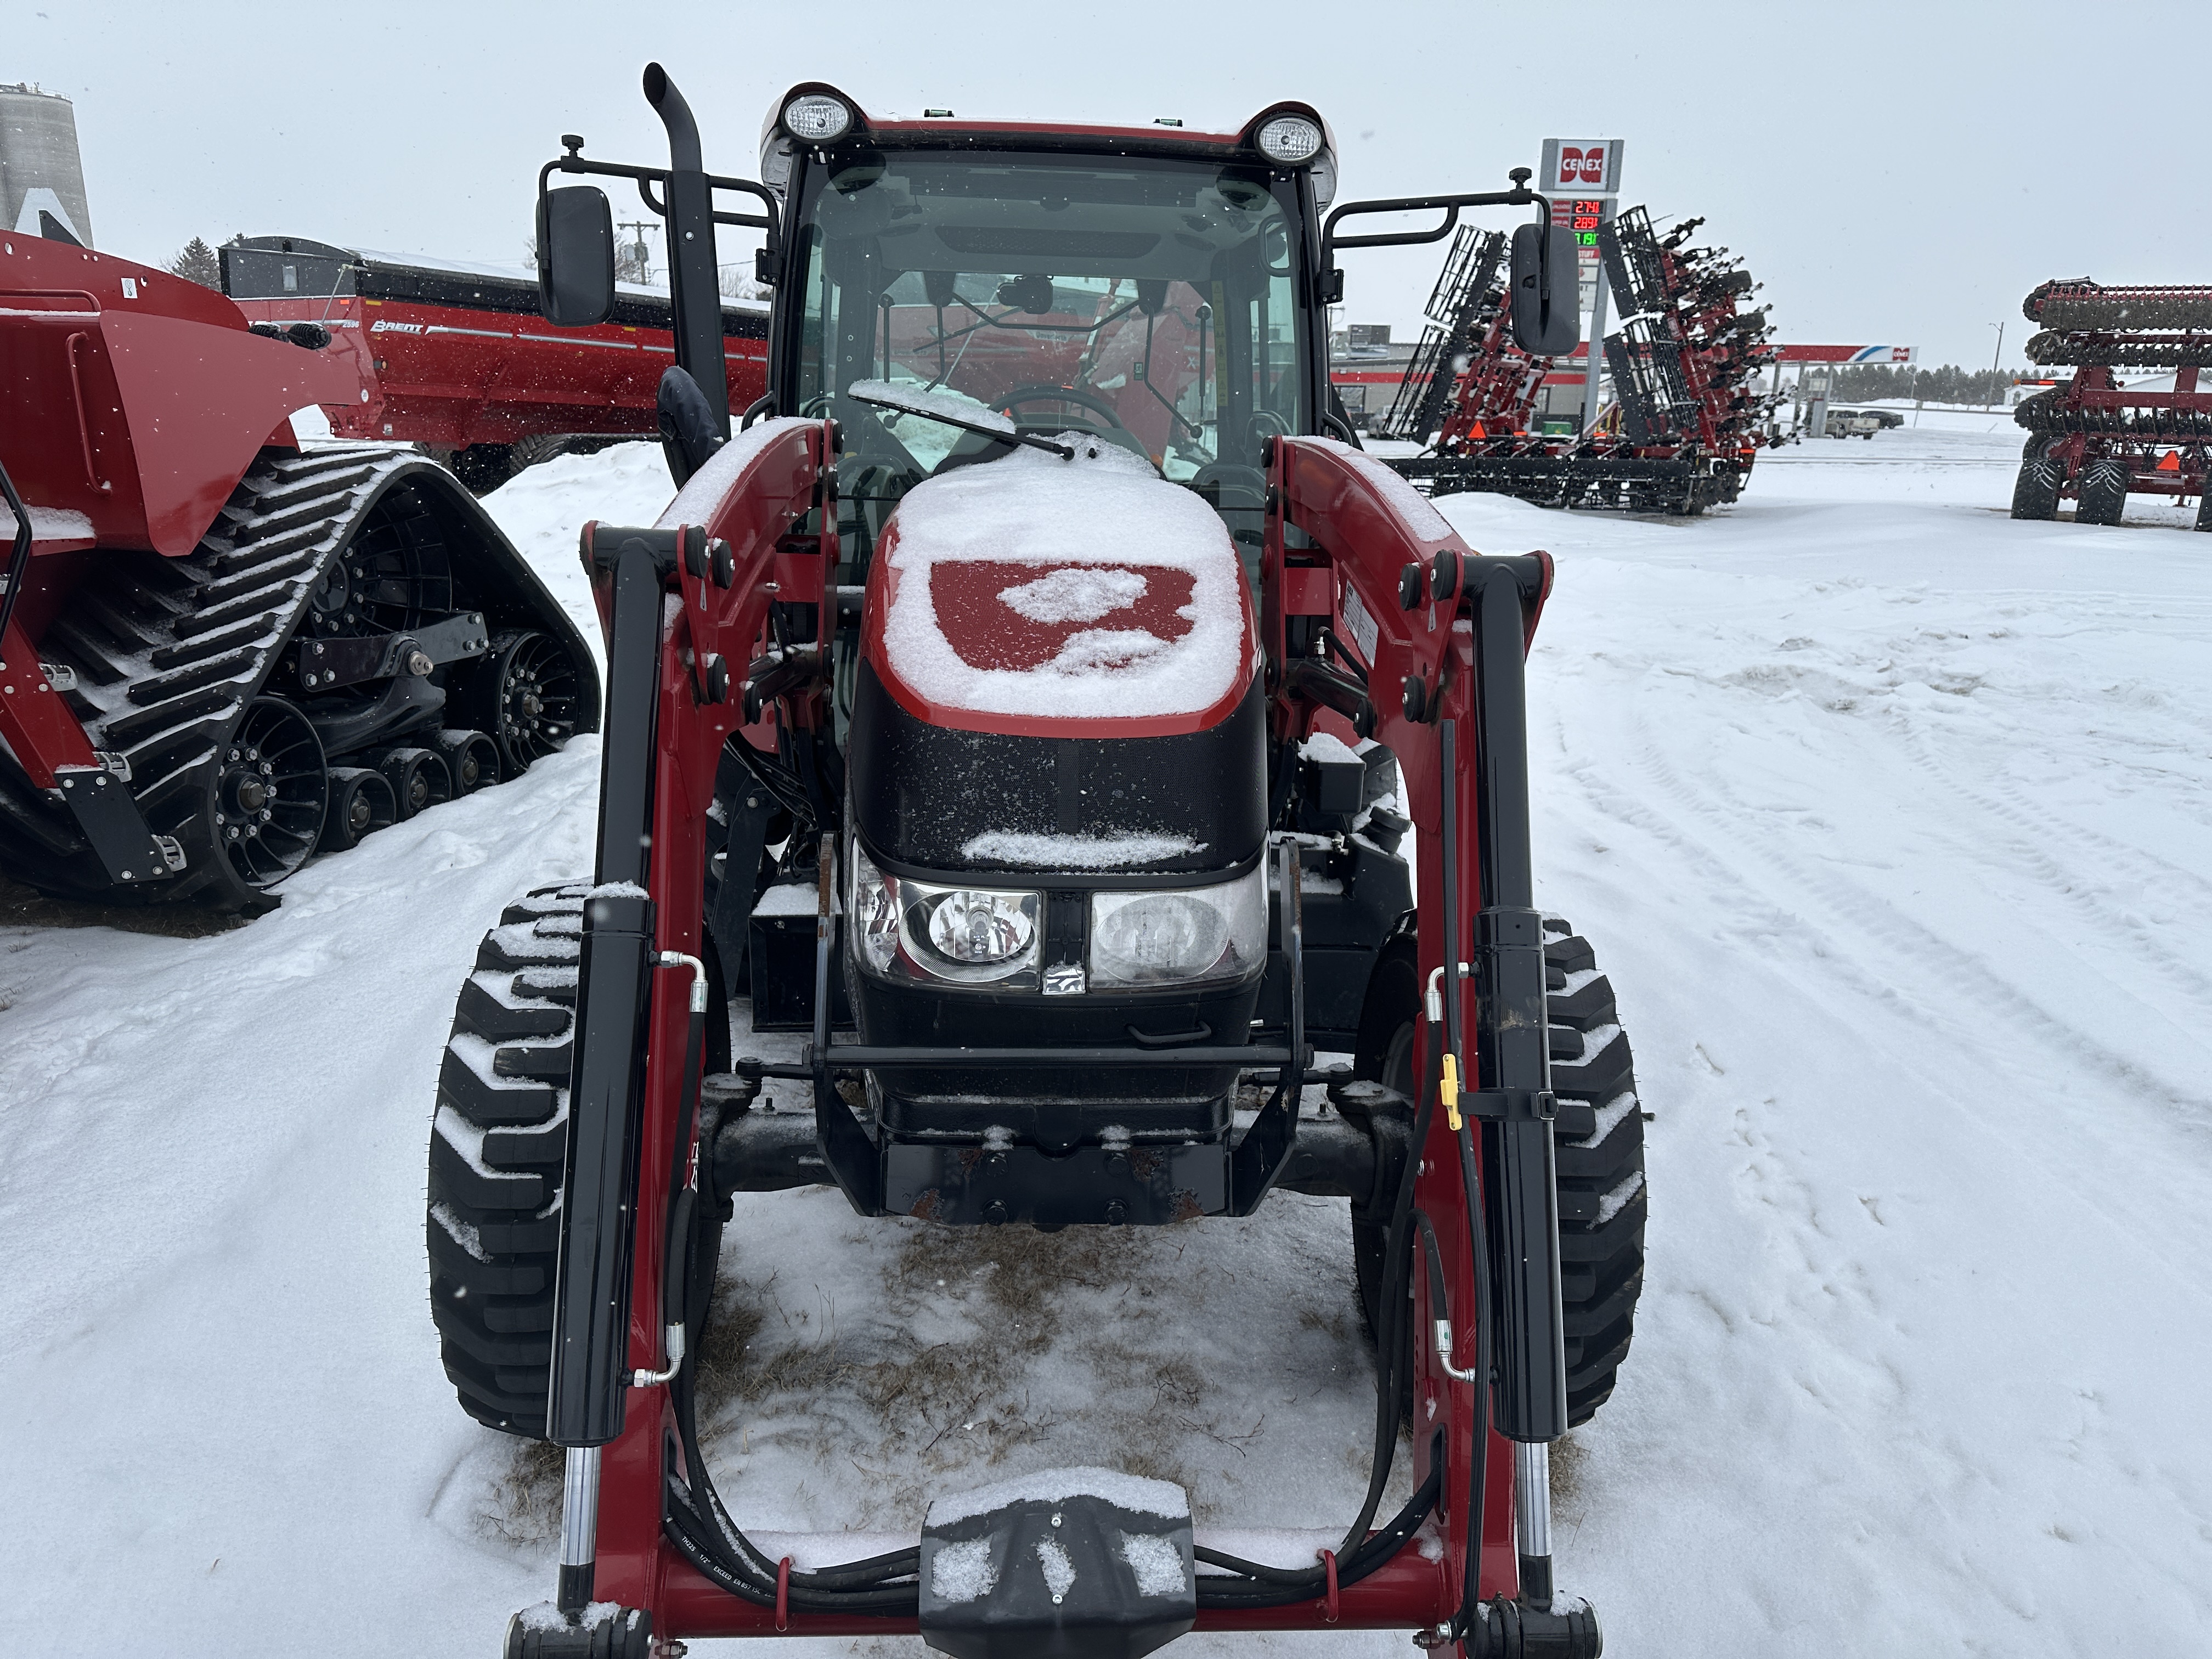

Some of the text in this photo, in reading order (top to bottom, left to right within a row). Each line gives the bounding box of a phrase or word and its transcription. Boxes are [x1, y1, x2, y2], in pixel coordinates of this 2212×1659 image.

[1562, 158, 1602, 171] CENEX
[681, 1536, 697, 1552] TH225
[713, 1566, 732, 1581] EXCEED
[741, 1582, 752, 1590] 857
